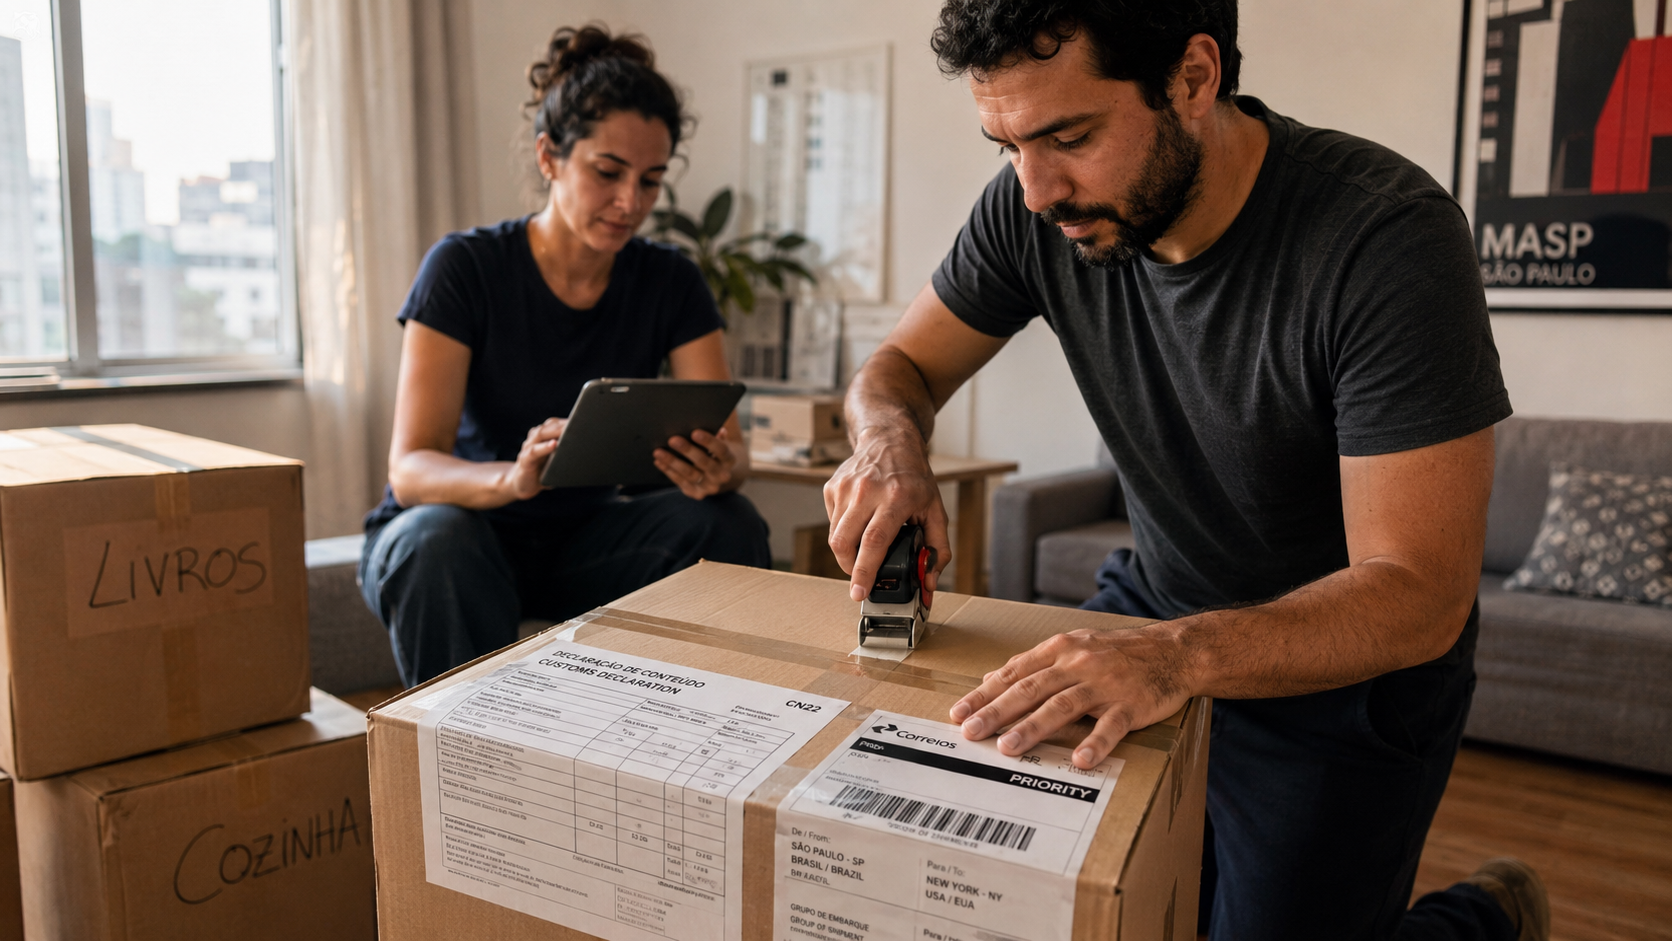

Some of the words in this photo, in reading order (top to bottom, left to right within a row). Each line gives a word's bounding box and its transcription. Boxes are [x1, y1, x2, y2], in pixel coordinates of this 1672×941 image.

[1481, 222, 1594, 260] MASP
[1526, 262, 1596, 286] PAULO
[90, 541, 267, 609] LIVROS
[538, 658, 599, 677] CUSTOMS
[596, 671, 682, 696] DECLARATION
[622, 665, 642, 674] DE
[640, 669, 706, 689] CONTEÚDO
[785, 700, 822, 713] CN22
[1009, 774, 1092, 798] PRIORITY
[791, 827, 802, 836] De
[808, 831, 831, 844] From:
[174, 797, 362, 905] COZINHA
[812, 846, 845, 862] PAULO
[851, 857, 865, 866] SP
[791, 854, 823, 871] BRASIL
[830, 865, 864, 882] BRAZIL
[926, 860, 947, 873] Para
[925, 889, 947, 903] USA
[953, 896, 976, 910] EUA
[926, 875, 950, 889] NEW
[951, 881, 980, 898] YORK
[988, 891, 1003, 902] NY
[790, 903, 816, 916] GRUPO
[817, 910, 827, 920] DE
[828, 913, 870, 932] EMBARQUE
[790, 915, 816, 928] GROUP
